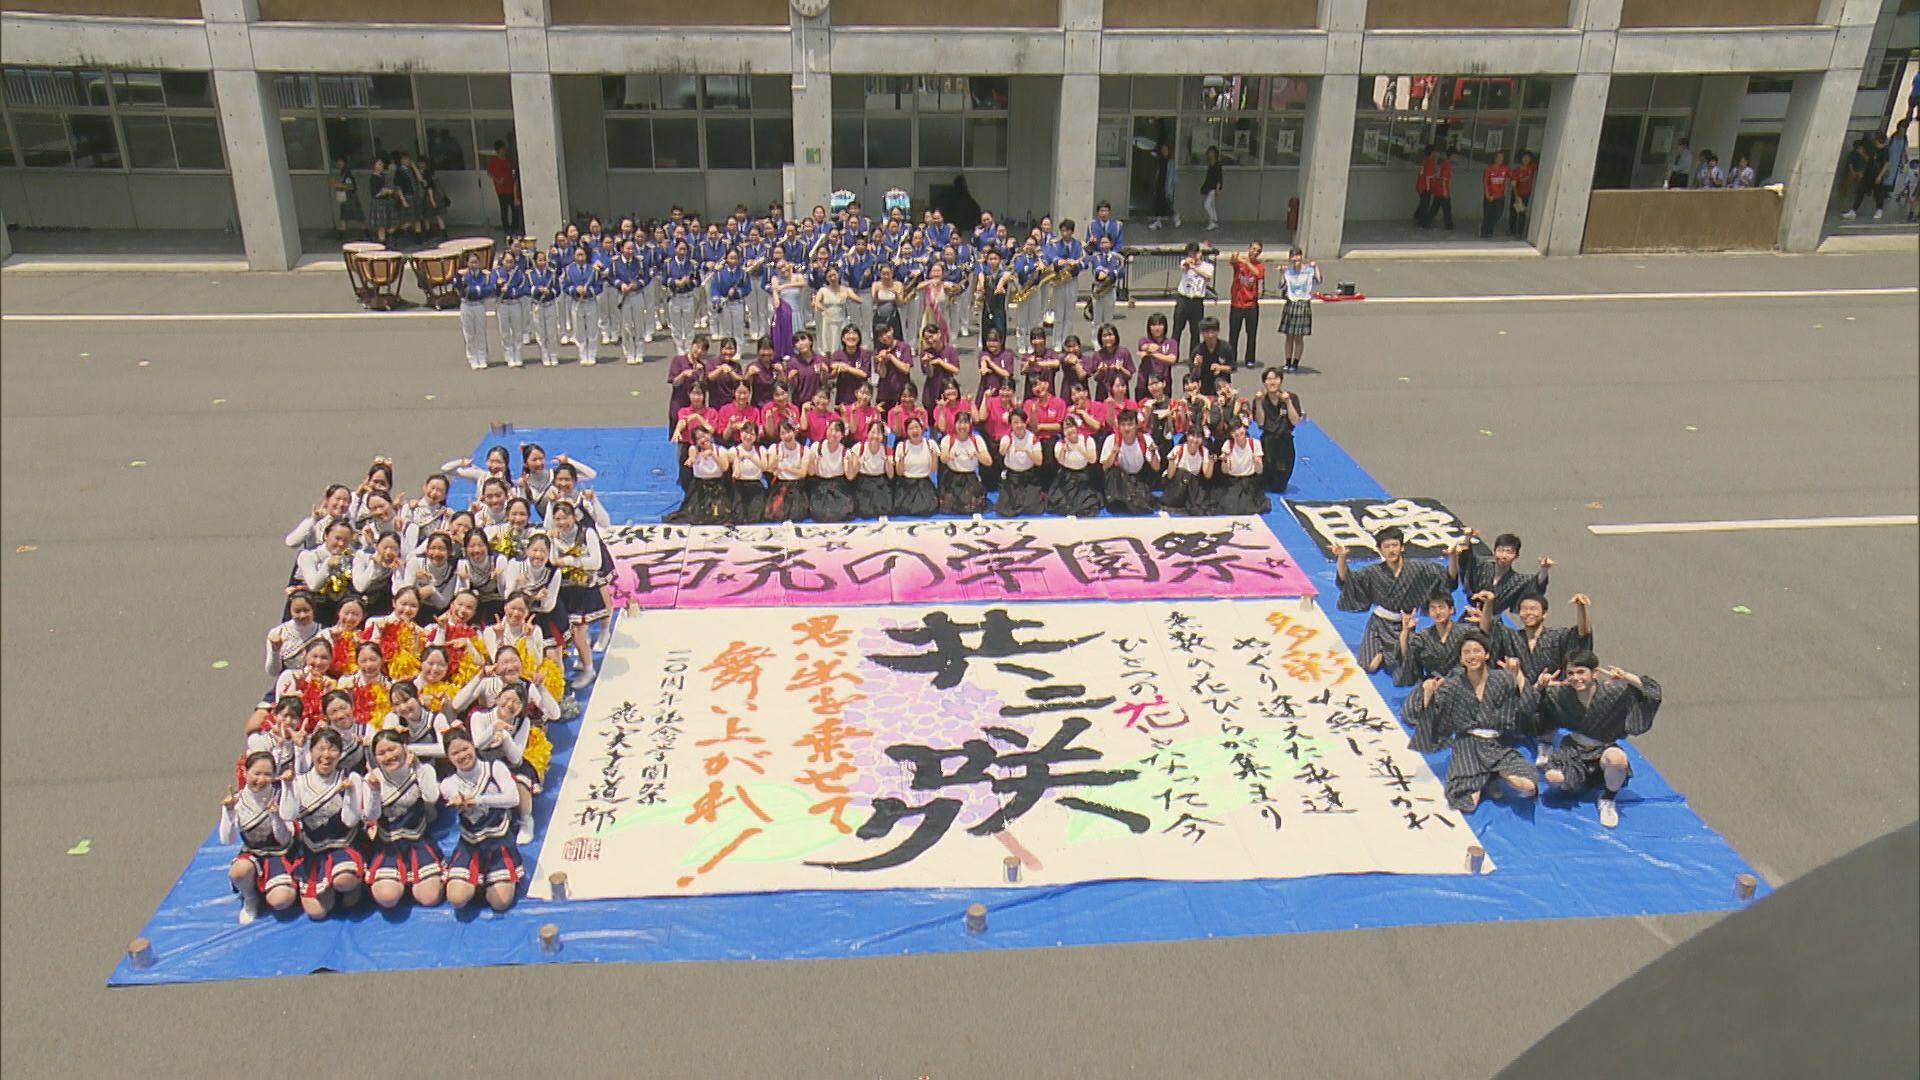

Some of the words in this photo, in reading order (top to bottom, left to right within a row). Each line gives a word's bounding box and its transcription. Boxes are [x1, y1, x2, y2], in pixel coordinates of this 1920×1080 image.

[785, 614, 873, 834] 思い出を乗せて
